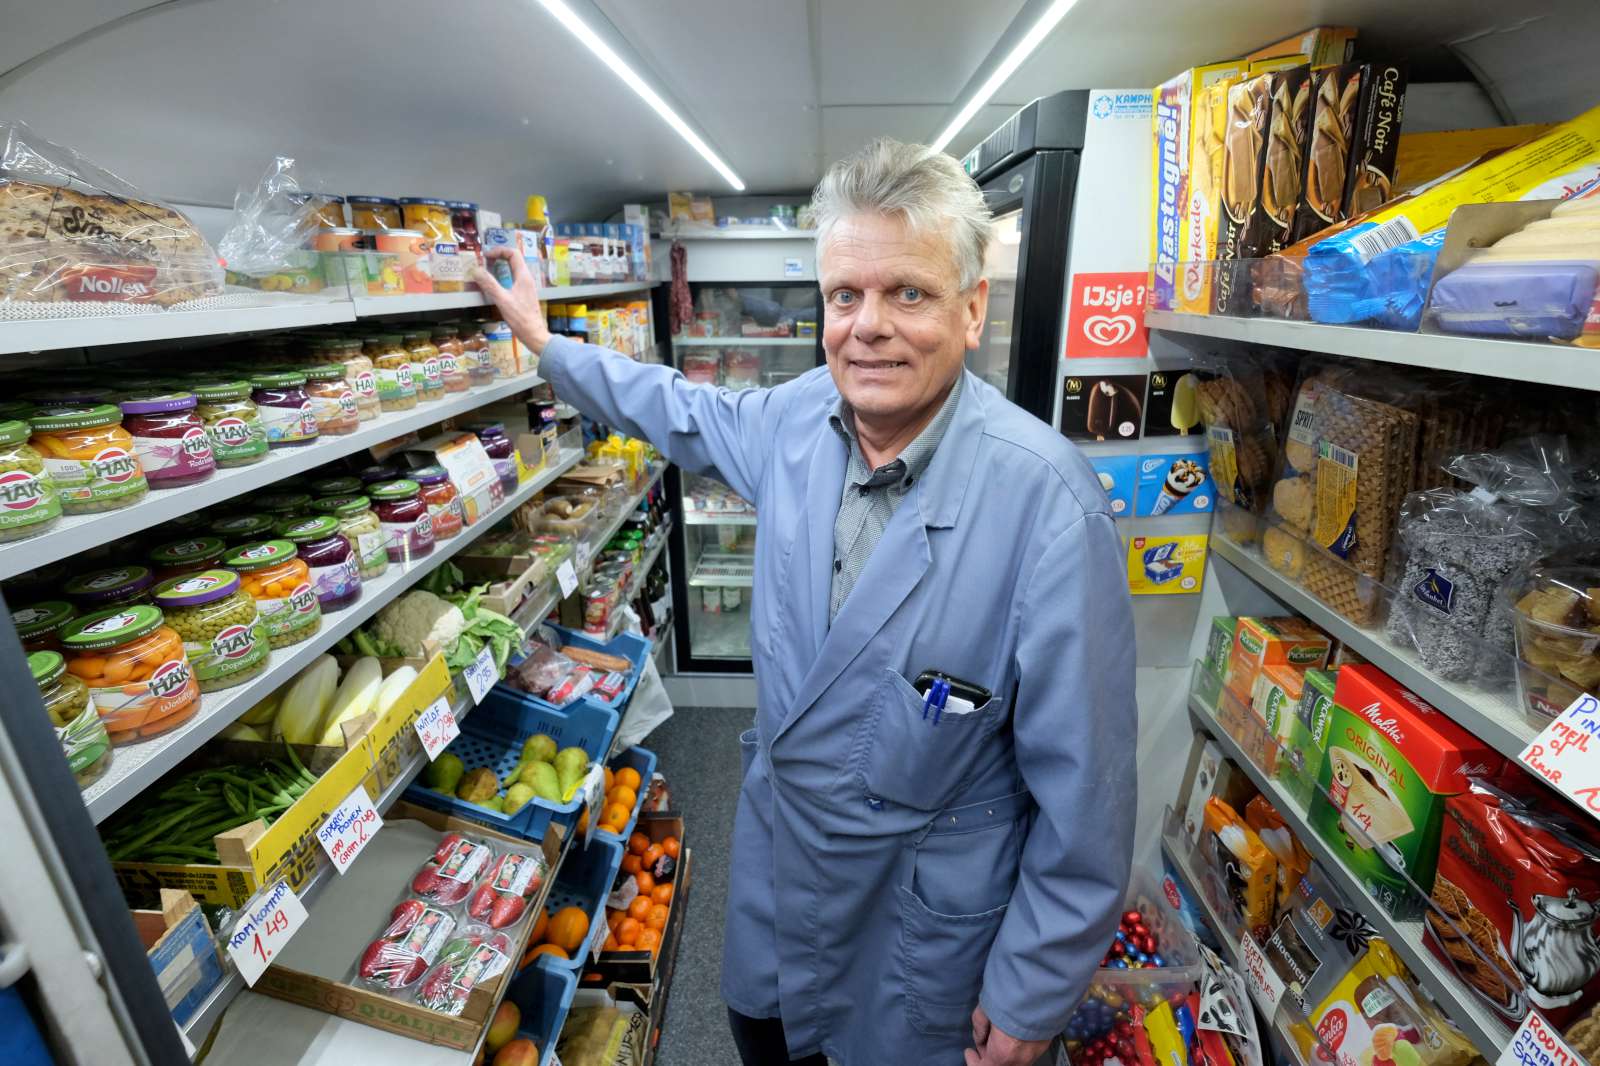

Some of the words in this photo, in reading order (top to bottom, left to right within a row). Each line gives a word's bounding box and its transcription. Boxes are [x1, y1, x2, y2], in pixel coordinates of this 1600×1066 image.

[1379, 67, 1399, 107] Café
[1374, 111, 1392, 153] Noir
[1156, 103, 1180, 285] Bastogne!
[1186, 199, 1202, 292] Verkade
[213, 424, 252, 442] HAK
[92, 456, 136, 478] HAK
[212, 628, 256, 656] HAK
[148, 663, 190, 697] HAK
[1360, 702, 1404, 744] Melitta
[1345, 727, 1407, 791] ORIGINAL
